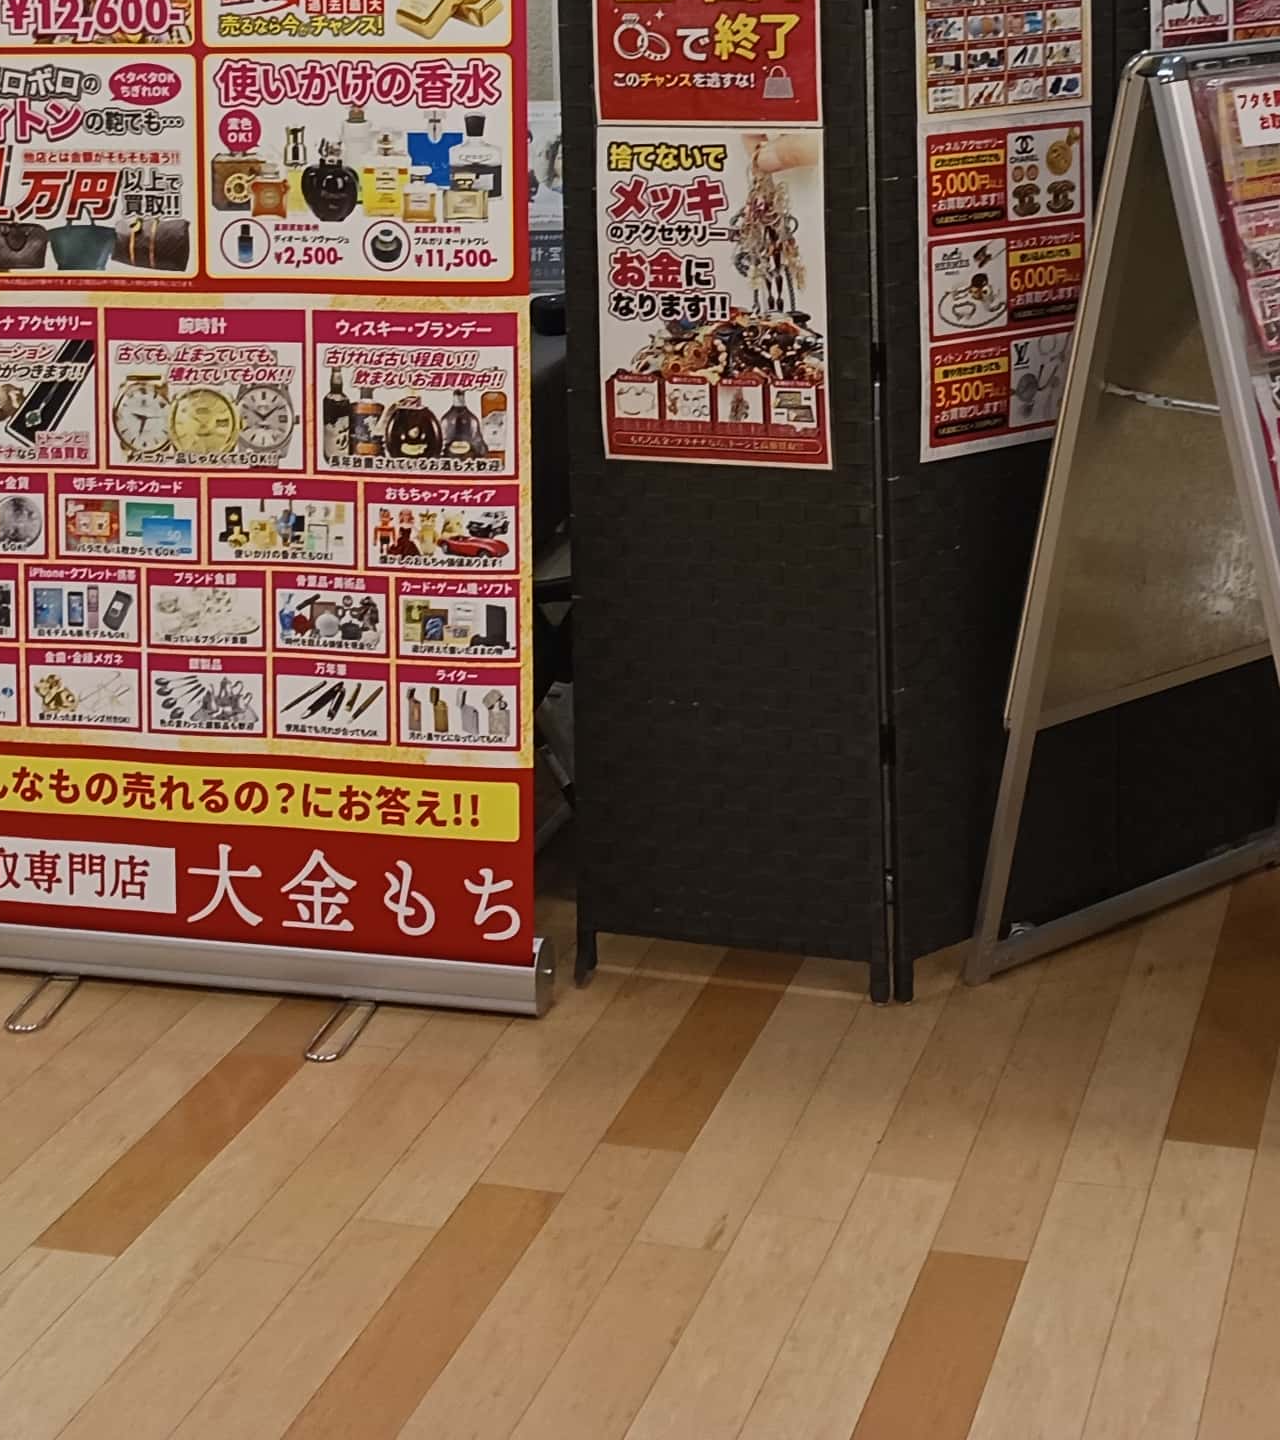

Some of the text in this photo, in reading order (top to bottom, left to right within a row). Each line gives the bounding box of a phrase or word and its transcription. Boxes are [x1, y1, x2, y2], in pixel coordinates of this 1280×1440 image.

[676, 13, 800, 61] で終了
[216, 60, 501, 108] 使いかけの香水
[227, 131, 252, 143] OK!
[608, 143, 726, 171] 捨てないで
[124, 194, 181, 216] 買取!!
[609, 177, 728, 222] メッキ
[610, 223, 728, 243] のアクセサリー
[610, 250, 713, 291] お金に
[610, 294, 730, 320] なります!!
[18, 316, 93, 331] アクセサリー
[178, 317, 227, 334] 腕時計
[335, 319, 492, 338] ウィスキー・ブランデー
[271, 482, 297, 496] 香水
[436, 670, 478, 681] ライター
[187, 844, 521, 941] 大金もち
